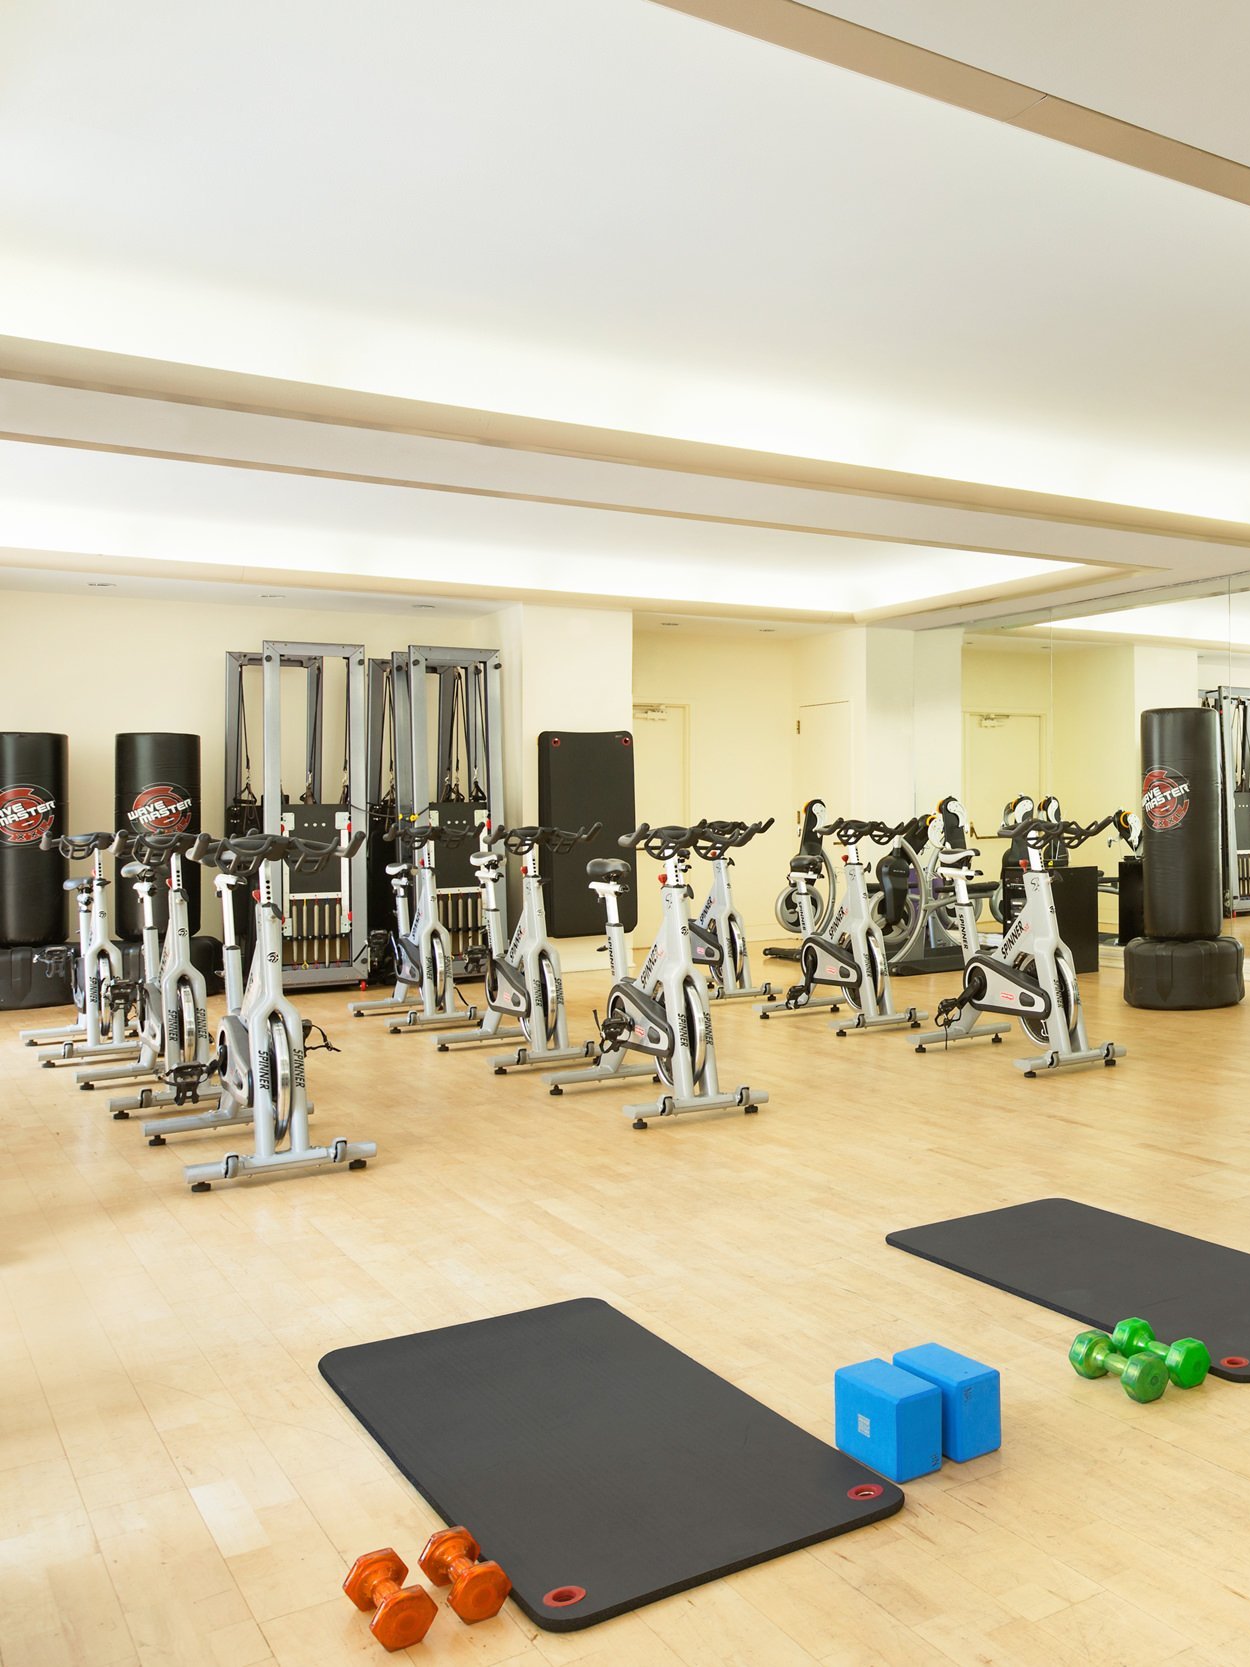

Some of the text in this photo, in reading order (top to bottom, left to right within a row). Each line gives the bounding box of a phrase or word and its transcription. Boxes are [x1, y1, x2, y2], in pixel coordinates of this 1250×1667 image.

[127, 801, 166, 822] WAVE
[139, 799, 192, 825] MASTER
[1143, 786, 1162, 807] AVE
[1145, 783, 1190, 812] MASTER
[959, 914, 969, 950] SPINNER
[1001, 921, 1025, 960] SPINNER
[168, 1009, 178, 1042] SPINNER
[678, 1013, 689, 1048] SPINNER
[703, 1011, 714, 1046] SPINNER
[258, 1049, 271, 1090] SPINNER
[293, 1048, 306, 1089] SPINNER
